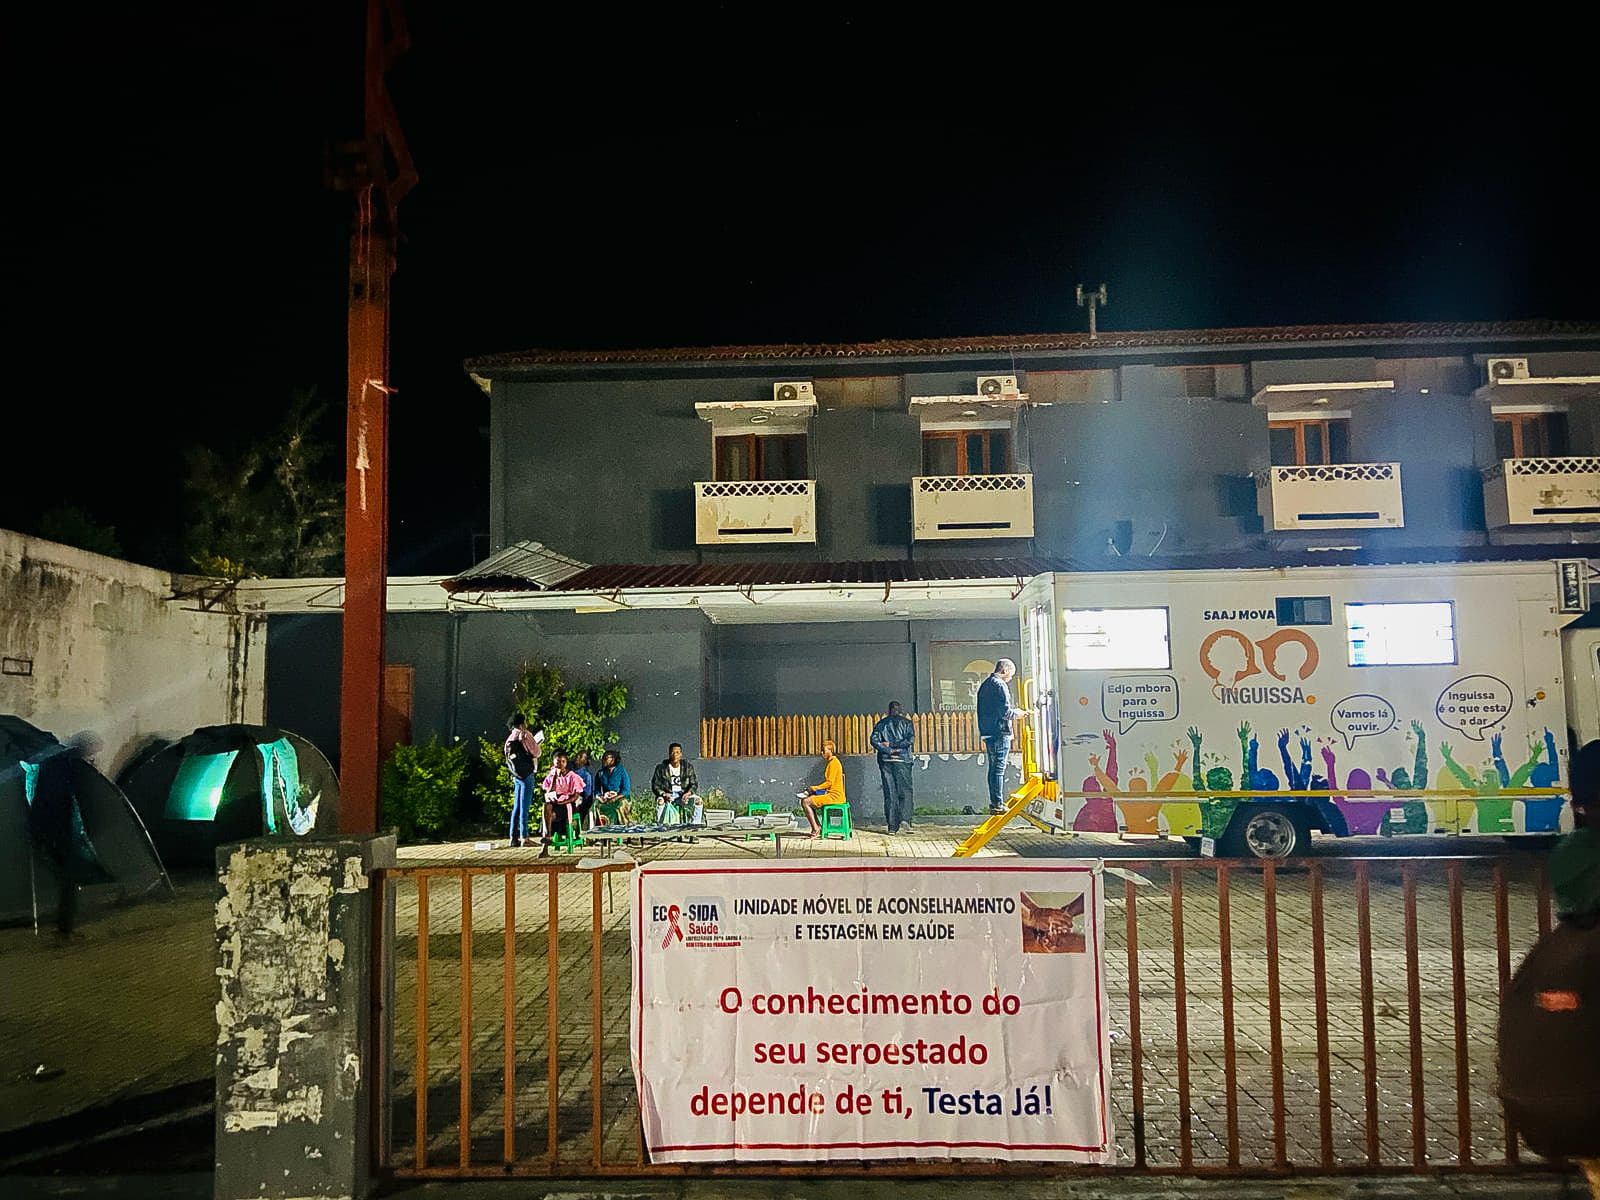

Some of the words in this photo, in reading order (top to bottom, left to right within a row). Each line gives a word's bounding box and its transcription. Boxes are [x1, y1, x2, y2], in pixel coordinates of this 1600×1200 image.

[1204, 610, 1236, 620] SAAJ
[1239, 610, 1276, 620] MOVA
[1108, 684, 1132, 694] Edjo
[1136, 684, 1171, 692] mbora
[1221, 687, 1305, 704] INGUISSA
[1449, 691, 1495, 702] Inguissa
[1123, 698, 1147, 707] para
[1119, 709, 1165, 720] Inguissa
[1337, 709, 1375, 719] Vamos
[1378, 708, 1388, 718] lá
[1439, 704, 1445, 713] é
[1449, 705, 1456, 713] o
[1459, 705, 1480, 715] que
[1483, 704, 1507, 713] esta
[1348, 722, 1380, 731] ouvir.
[1460, 718, 1466, 726] a
[1469, 717, 1488, 726] dar
[734, 899, 798, 915] UNIDADE
[802, 894, 852, 915] MÓVEL
[856, 898, 873, 914] DE
[877, 897, 1016, 914] ACONSELHAMENTO
[688, 922, 719, 935] Saúde
[795, 924, 802, 940] E
[806, 924, 878, 940] TESTAGEM
[882, 924, 901, 940] EM
[907, 919, 955, 940] SAÚDE
[720, 987, 742, 1014] O
[751, 986, 972, 1015] conhecimento
[982, 986, 1021, 1015] do
[754, 1042, 806, 1064] seu
[816, 1035, 988, 1065] seroestado
[690, 1084, 825, 1121] depende
[835, 1084, 872, 1115] de
[882, 1086, 913, 1119] ti,
[922, 1087, 1003, 1115] Testa
[1011, 1085, 1053, 1116] Já!
